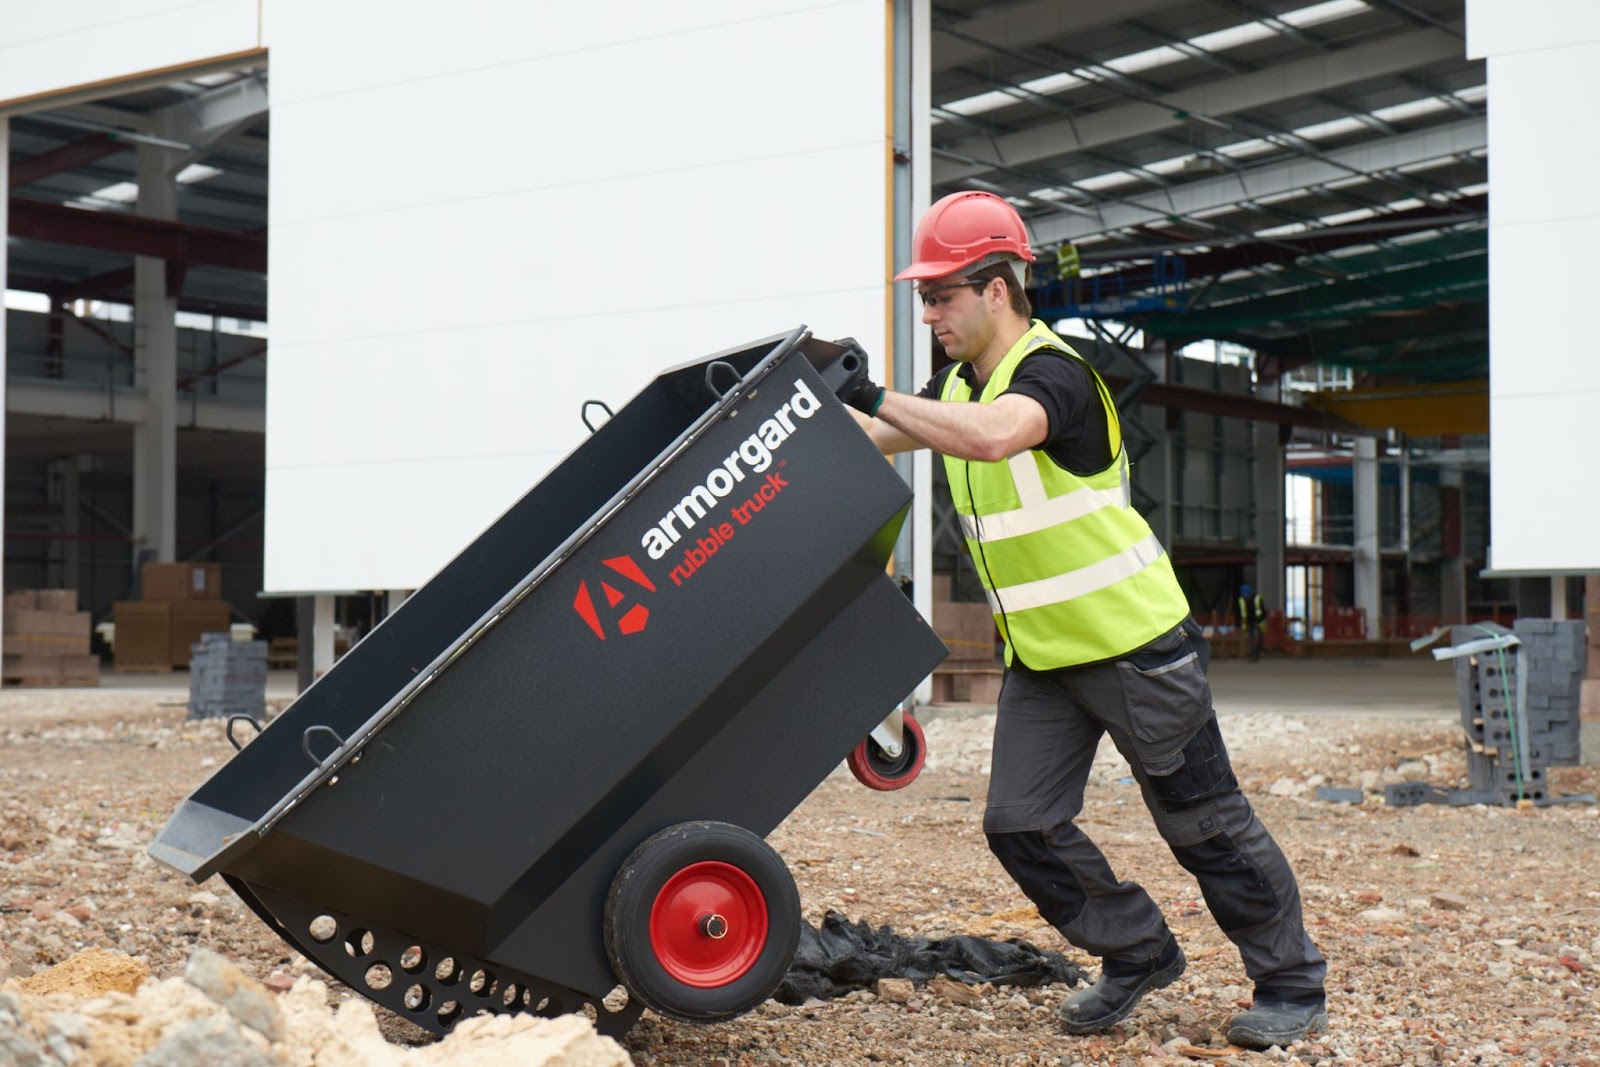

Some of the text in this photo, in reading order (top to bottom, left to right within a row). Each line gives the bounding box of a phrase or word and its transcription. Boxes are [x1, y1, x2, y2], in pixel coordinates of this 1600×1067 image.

[641, 378, 822, 560] armorgard
[668, 472, 789, 587] rubble truck
